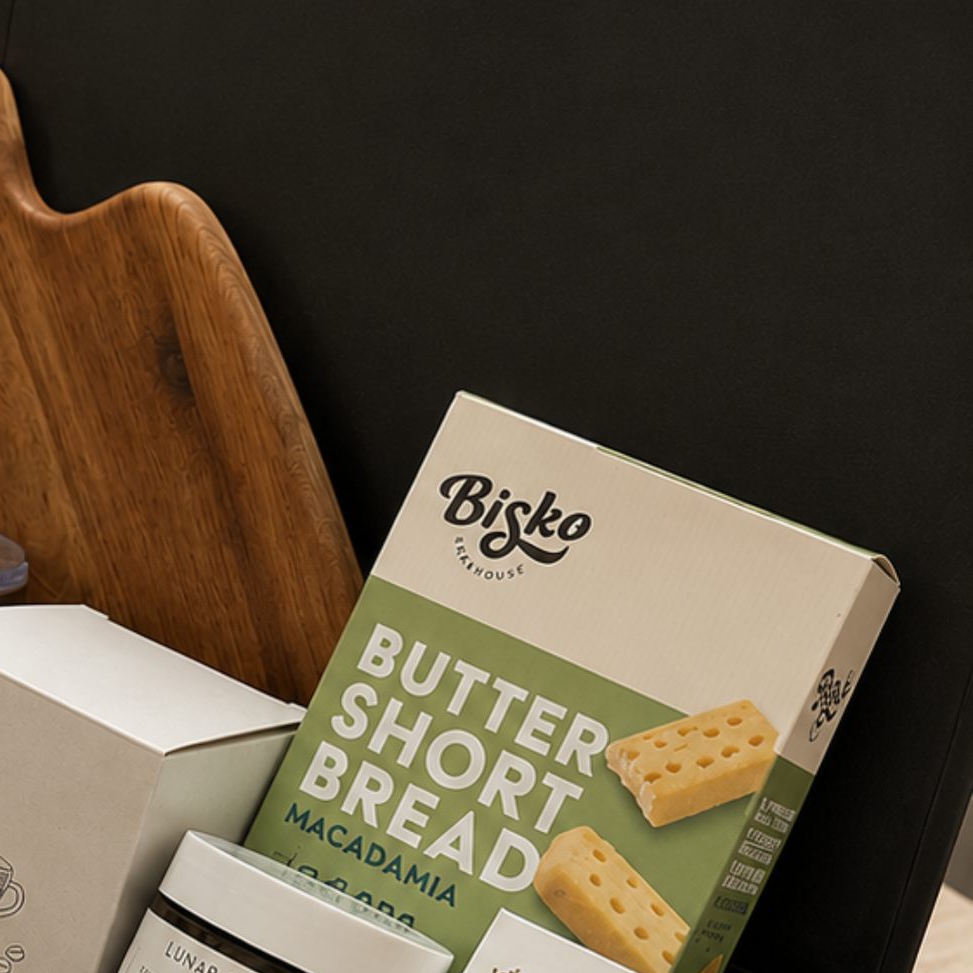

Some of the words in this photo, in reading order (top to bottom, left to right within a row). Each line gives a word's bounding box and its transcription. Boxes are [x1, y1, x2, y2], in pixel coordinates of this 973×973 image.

[440, 474, 592, 564] Bisko
[330, 682, 584, 835] SHORT
[357, 622, 609, 778] BUTTER
[284, 803, 457, 908] MACADAMIA
[299, 740, 541, 892] BREAD
